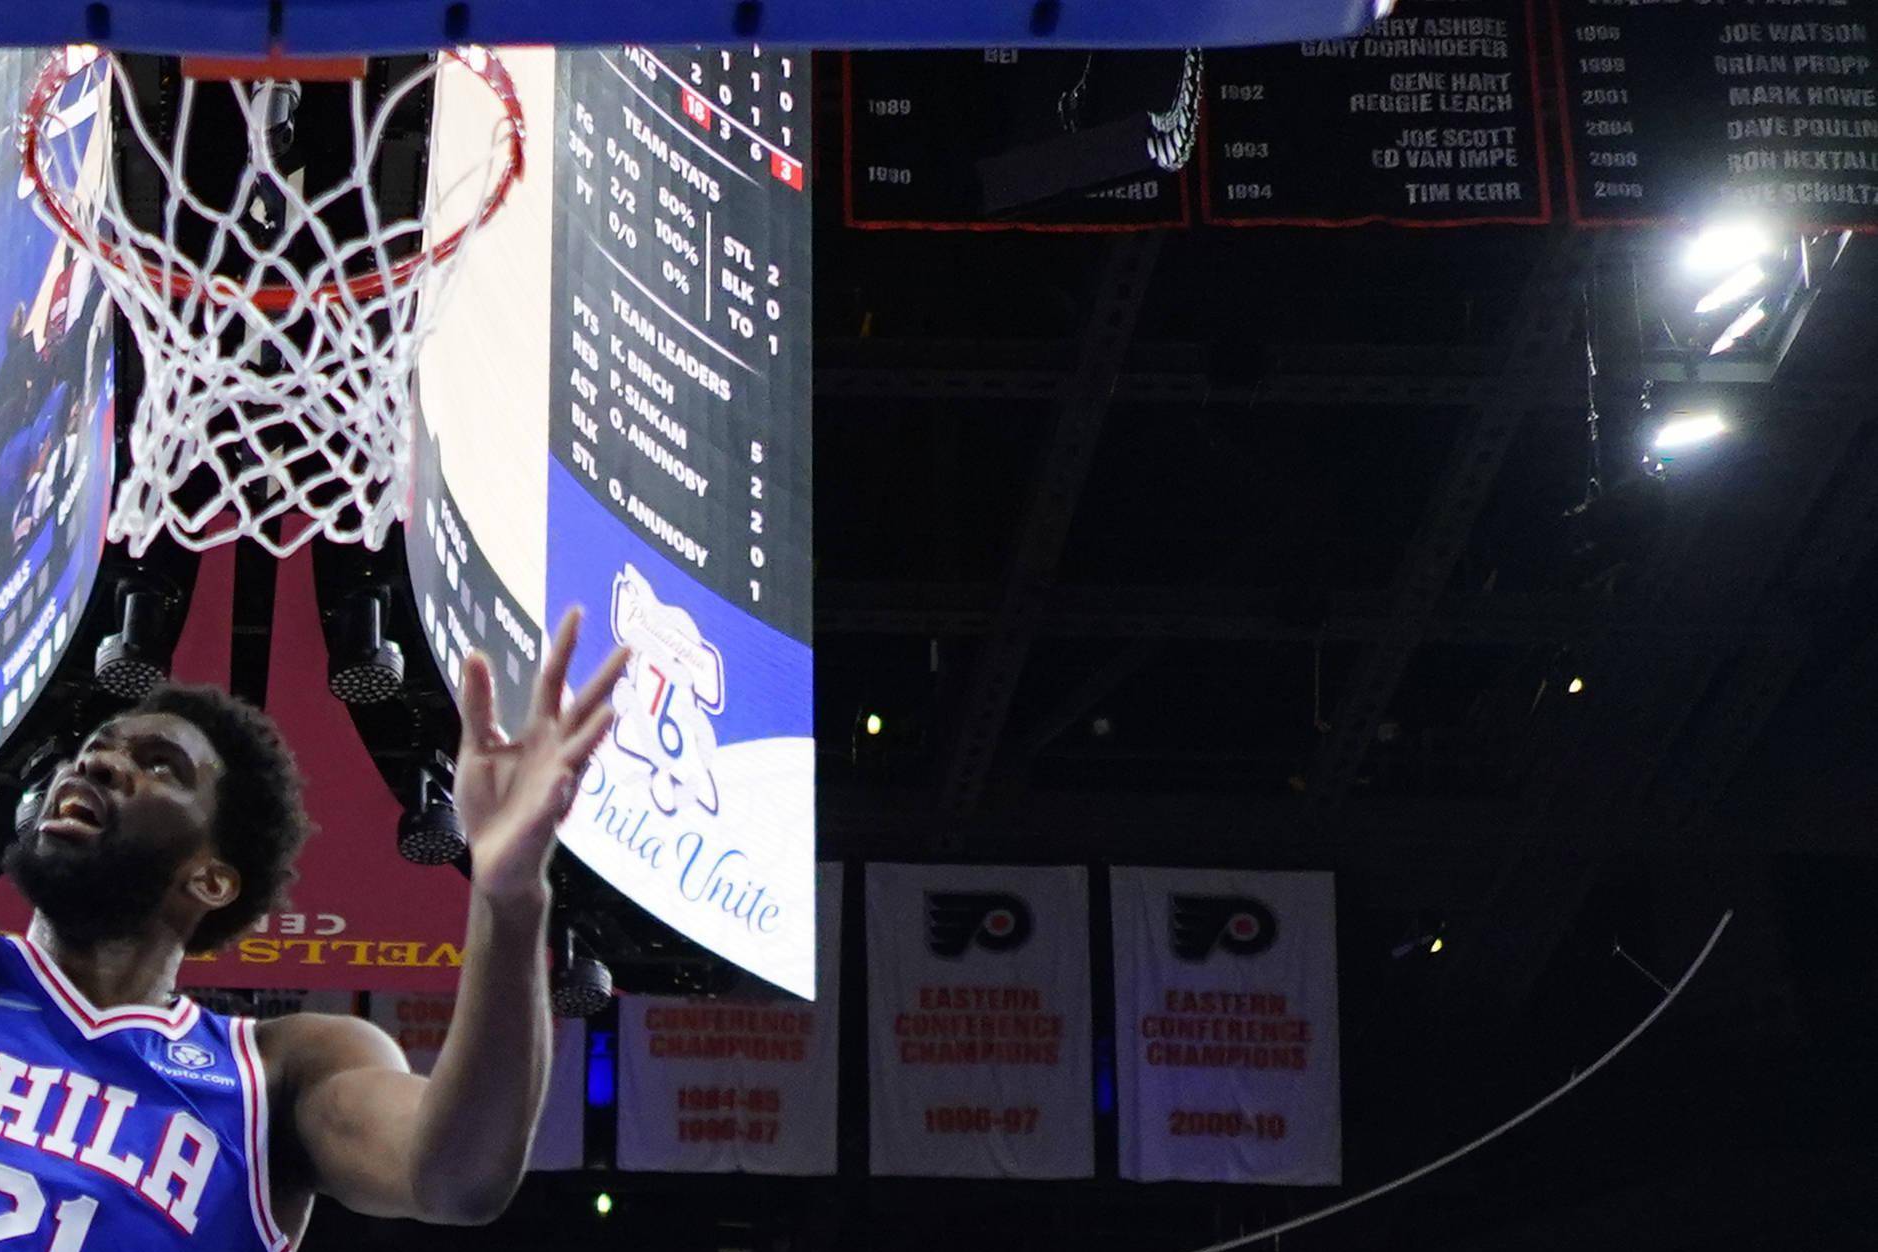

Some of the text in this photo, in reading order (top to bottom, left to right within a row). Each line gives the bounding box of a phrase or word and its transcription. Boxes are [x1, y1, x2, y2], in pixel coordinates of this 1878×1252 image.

[1719, 22, 1868, 43] JOE WATSON
[1451, 72, 1513, 92] HART
[1728, 86, 1802, 107] MARK
[685, 95, 705, 122] 18
[622, 105, 721, 203] TEAM STATS
[1395, 126, 1517, 149] JOE SCOTT
[1406, 149, 1454, 169] VAN
[1459, 148, 1521, 169] IMPE
[658, 186, 697, 229] 80%
[1405, 182, 1522, 204] TIM KERR
[610, 176, 637, 214] 2/2
[654, 217, 700, 267] 100%
[608, 211, 638, 249] 0/0
[662, 260, 691, 295] 0%
[723, 235, 780, 287] STL 2
[721, 268, 781, 321] BLK 0
[610, 289, 732, 402] TEAM LEADERS
[727, 307, 779, 356] TO 1
[573, 295, 600, 336] PTS
[626, 349, 675, 405] BIRCH
[750, 440, 763, 464] 5
[570, 367, 598, 406] AST
[627, 423, 709, 498] ANUNOBY
[750, 509, 763, 534] 2
[624, 384, 688, 450] SIAKAM
[750, 475, 763, 500] 2
[571, 440, 599, 481] STL
[626, 494, 710, 568] ANUNOBY
[749, 579, 761, 602] 1
[750, 546, 765, 569] 0
[494, 595, 536, 662] BONUS
[648, 664, 684, 760] 76
[676, 830, 781, 936] Unite
[919, 986, 1042, 1011] EASTERN
[1165, 990, 1287, 1016] EASTERN
[895, 1012, 1064, 1039] CONFERENCE
[1141, 1016, 1313, 1043] CONFERENCE
[649, 1036, 805, 1062] CHAMPIONS
[901, 1040, 1060, 1066] CHAMPIONS
[1146, 1042, 1307, 1070] CHAMPIONS
